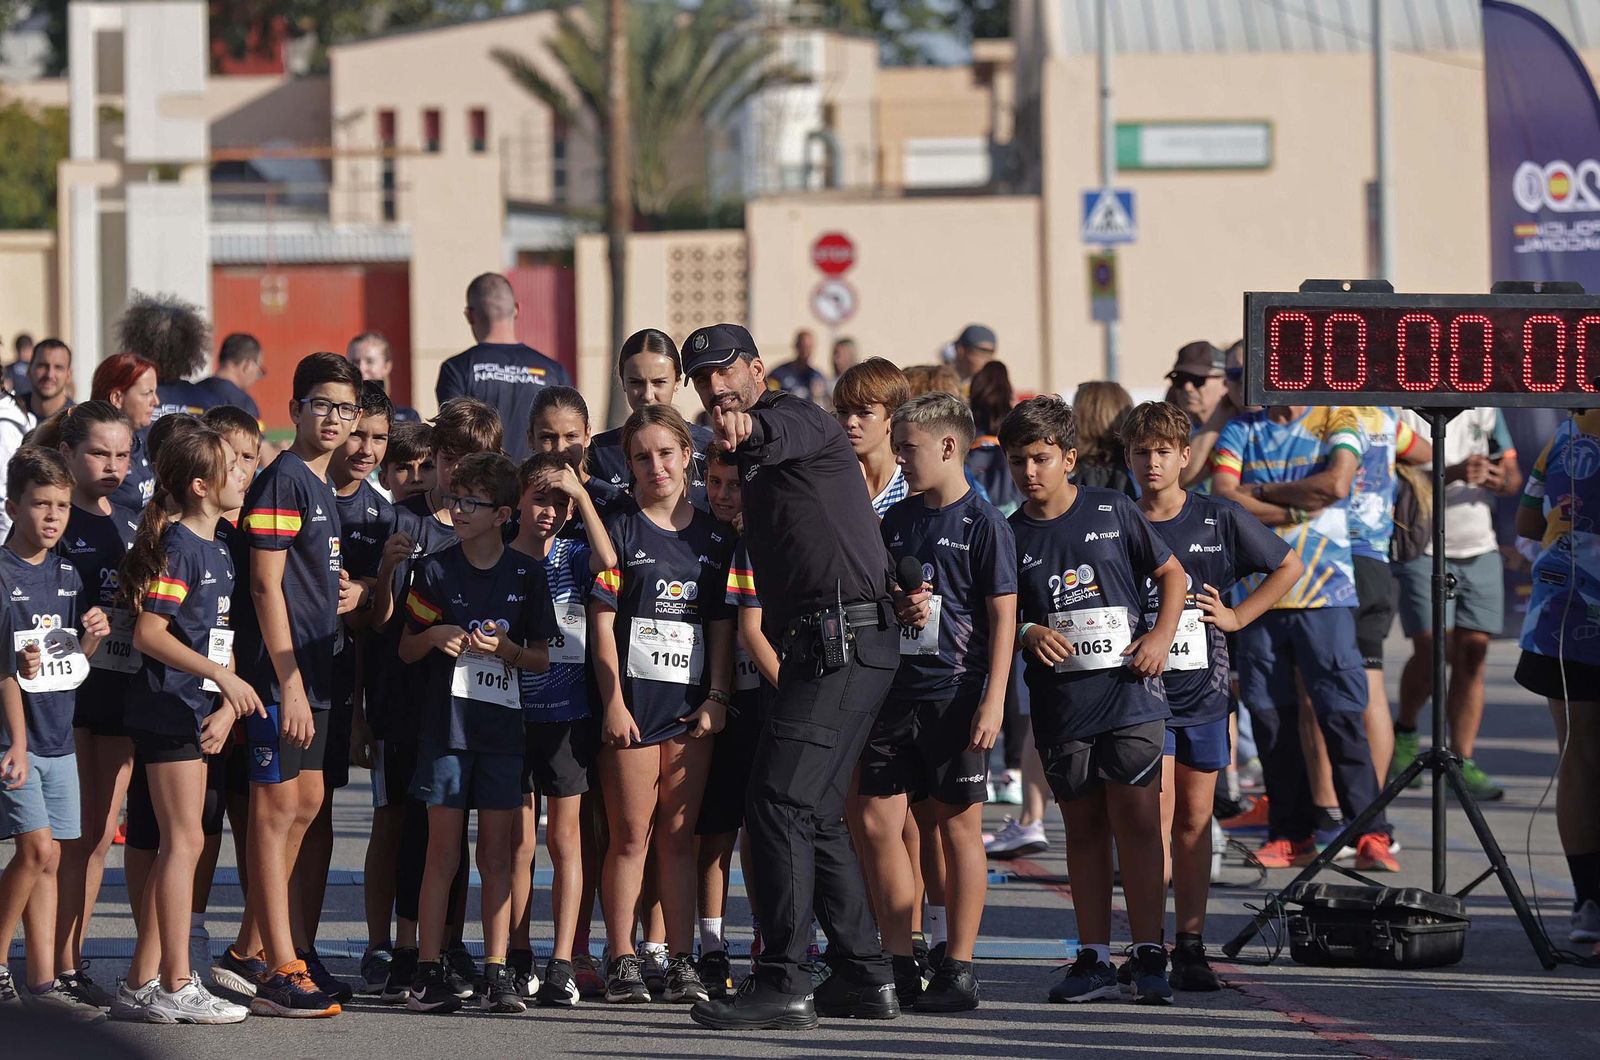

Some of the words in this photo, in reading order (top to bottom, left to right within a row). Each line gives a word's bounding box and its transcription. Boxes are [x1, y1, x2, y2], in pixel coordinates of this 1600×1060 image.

[473, 363, 529, 374] POLICIA
[474, 371, 545, 385] NACIONAL
[1100, 530, 1120, 540] mupol
[951, 542, 970, 551] mupol
[1204, 544, 1221, 553] mupol
[627, 558, 656, 567] Santander
[1048, 564, 1095, 596] 200
[656, 579, 698, 600] 200
[106, 640, 131, 657] 1020
[1074, 639, 1112, 656] 1063
[651, 651, 689, 668] 1105
[41, 661, 72, 676] 1113
[476, 671, 509, 691] 1016
